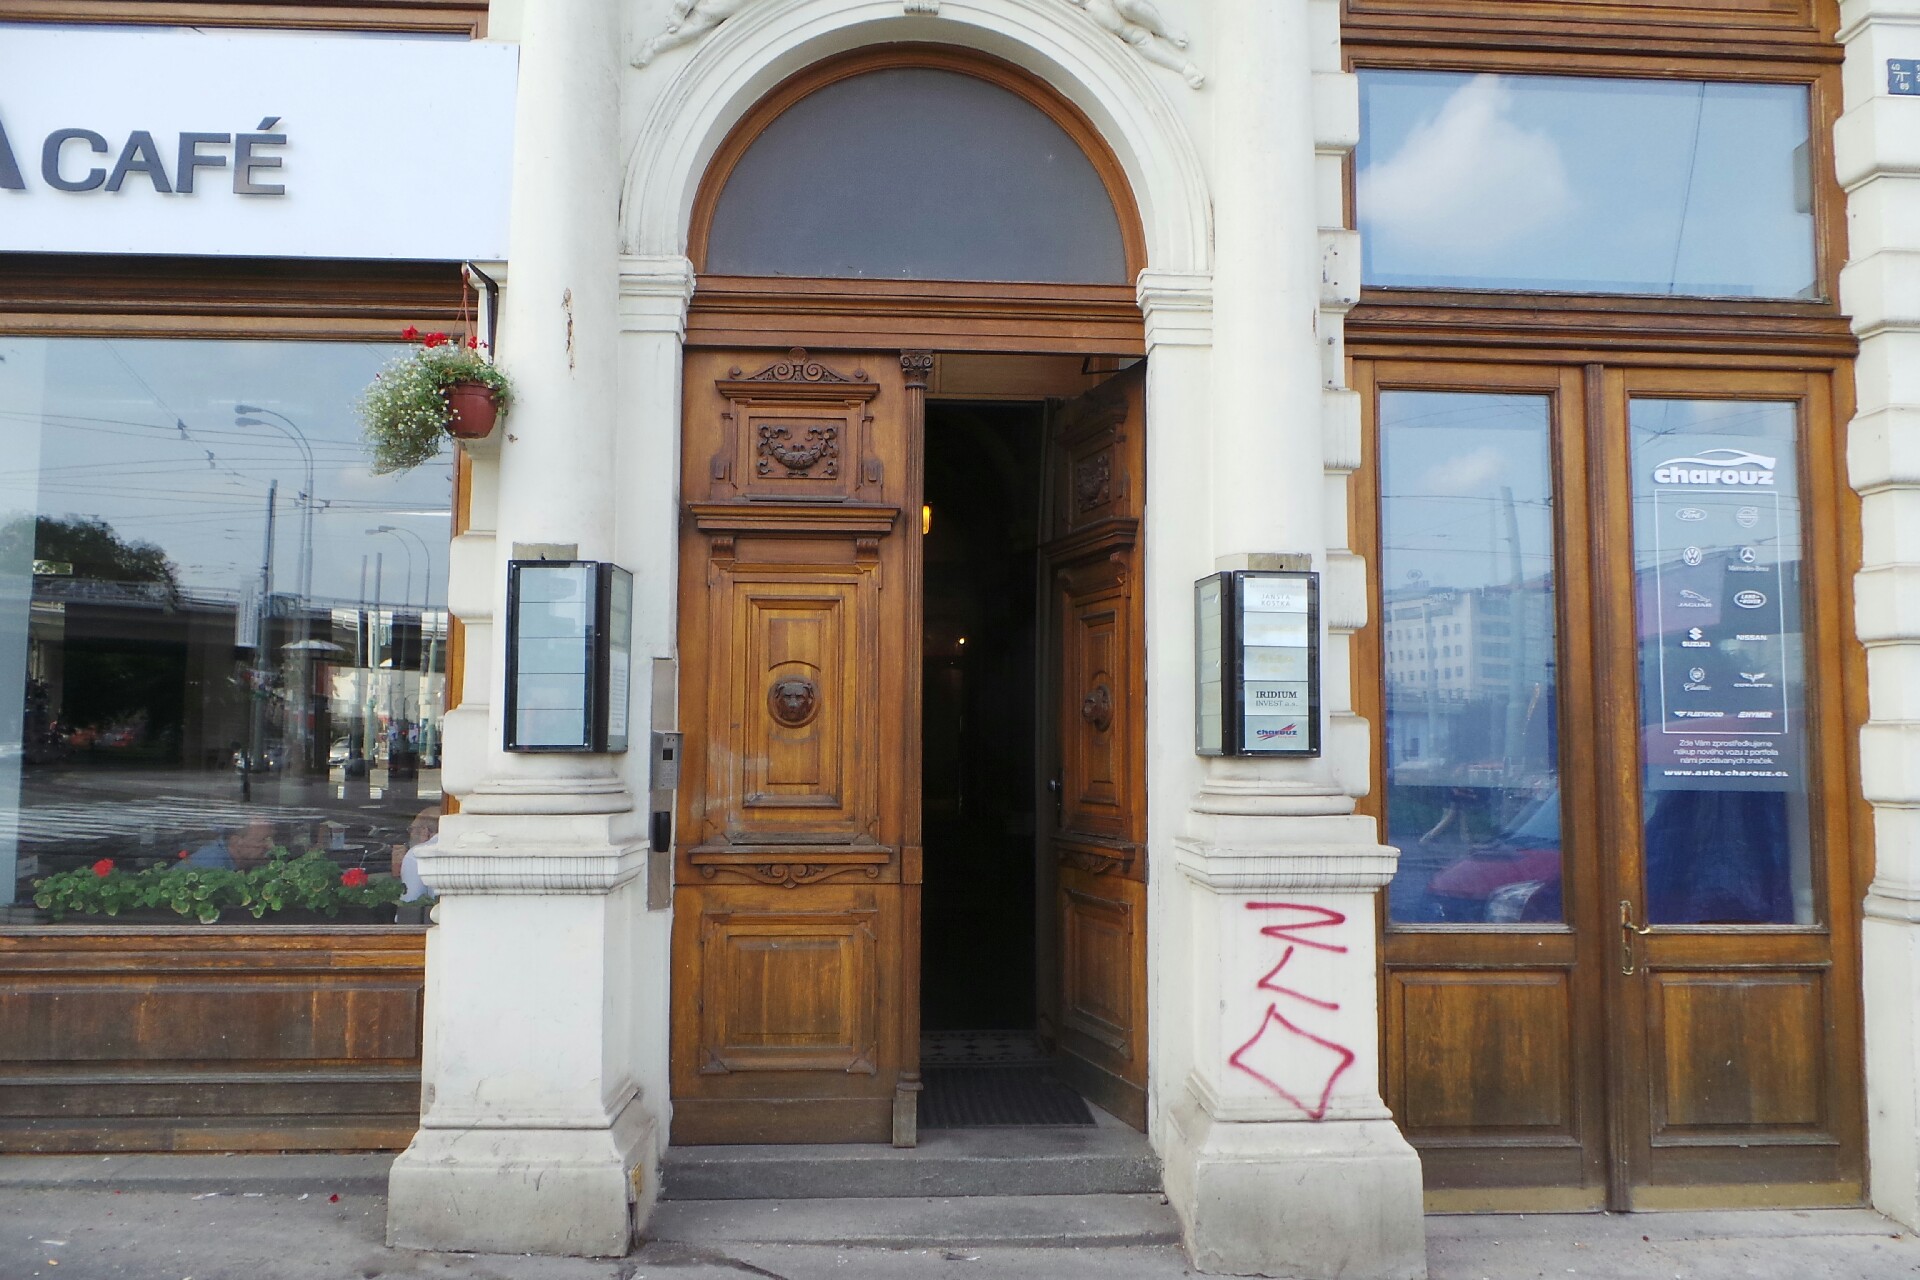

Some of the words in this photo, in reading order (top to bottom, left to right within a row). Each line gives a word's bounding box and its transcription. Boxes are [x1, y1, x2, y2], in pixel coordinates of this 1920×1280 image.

[41, 116, 287, 195] CAFÉ
[1654, 467, 1774, 485] charouz
[1256, 691, 1298, 699] IRIDIUM
